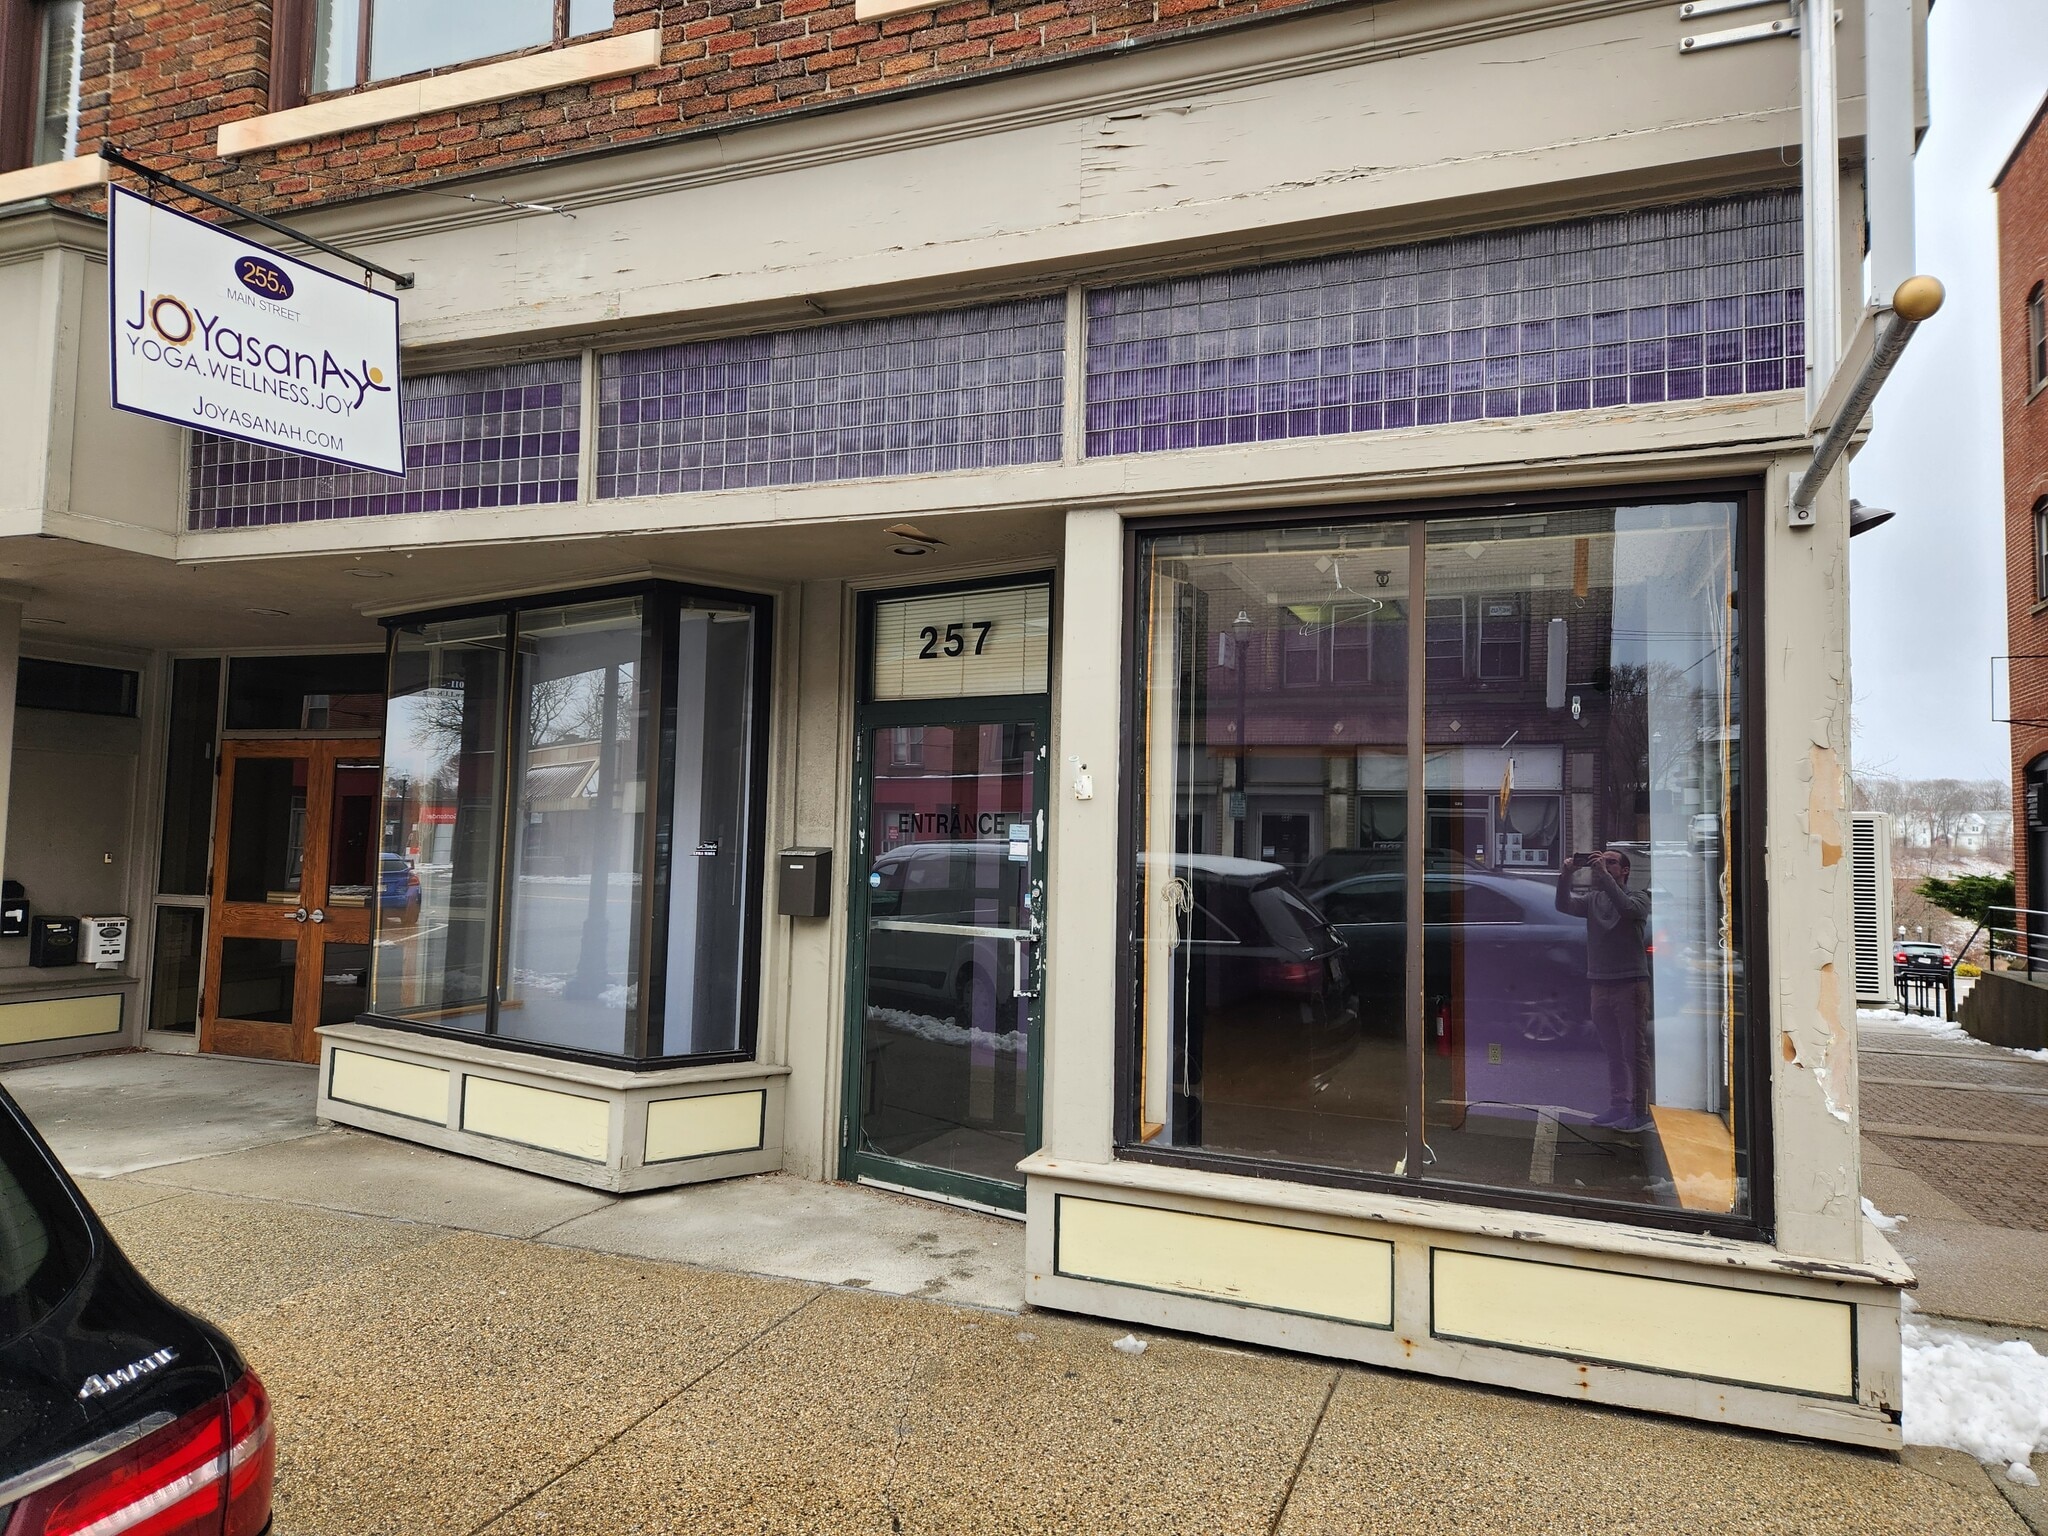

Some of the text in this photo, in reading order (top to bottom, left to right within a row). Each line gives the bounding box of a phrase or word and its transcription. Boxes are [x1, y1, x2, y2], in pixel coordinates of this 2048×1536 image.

[243, 261, 288, 297] 255A
[227, 288, 301, 322] MAIN STREET
[192, 396, 344, 452] JOYASANAH.COM
[918, 621, 992, 659] 257
[898, 812, 1006, 835] ENTRANCE
[78, 1345, 180, 1399] 4MATIC
